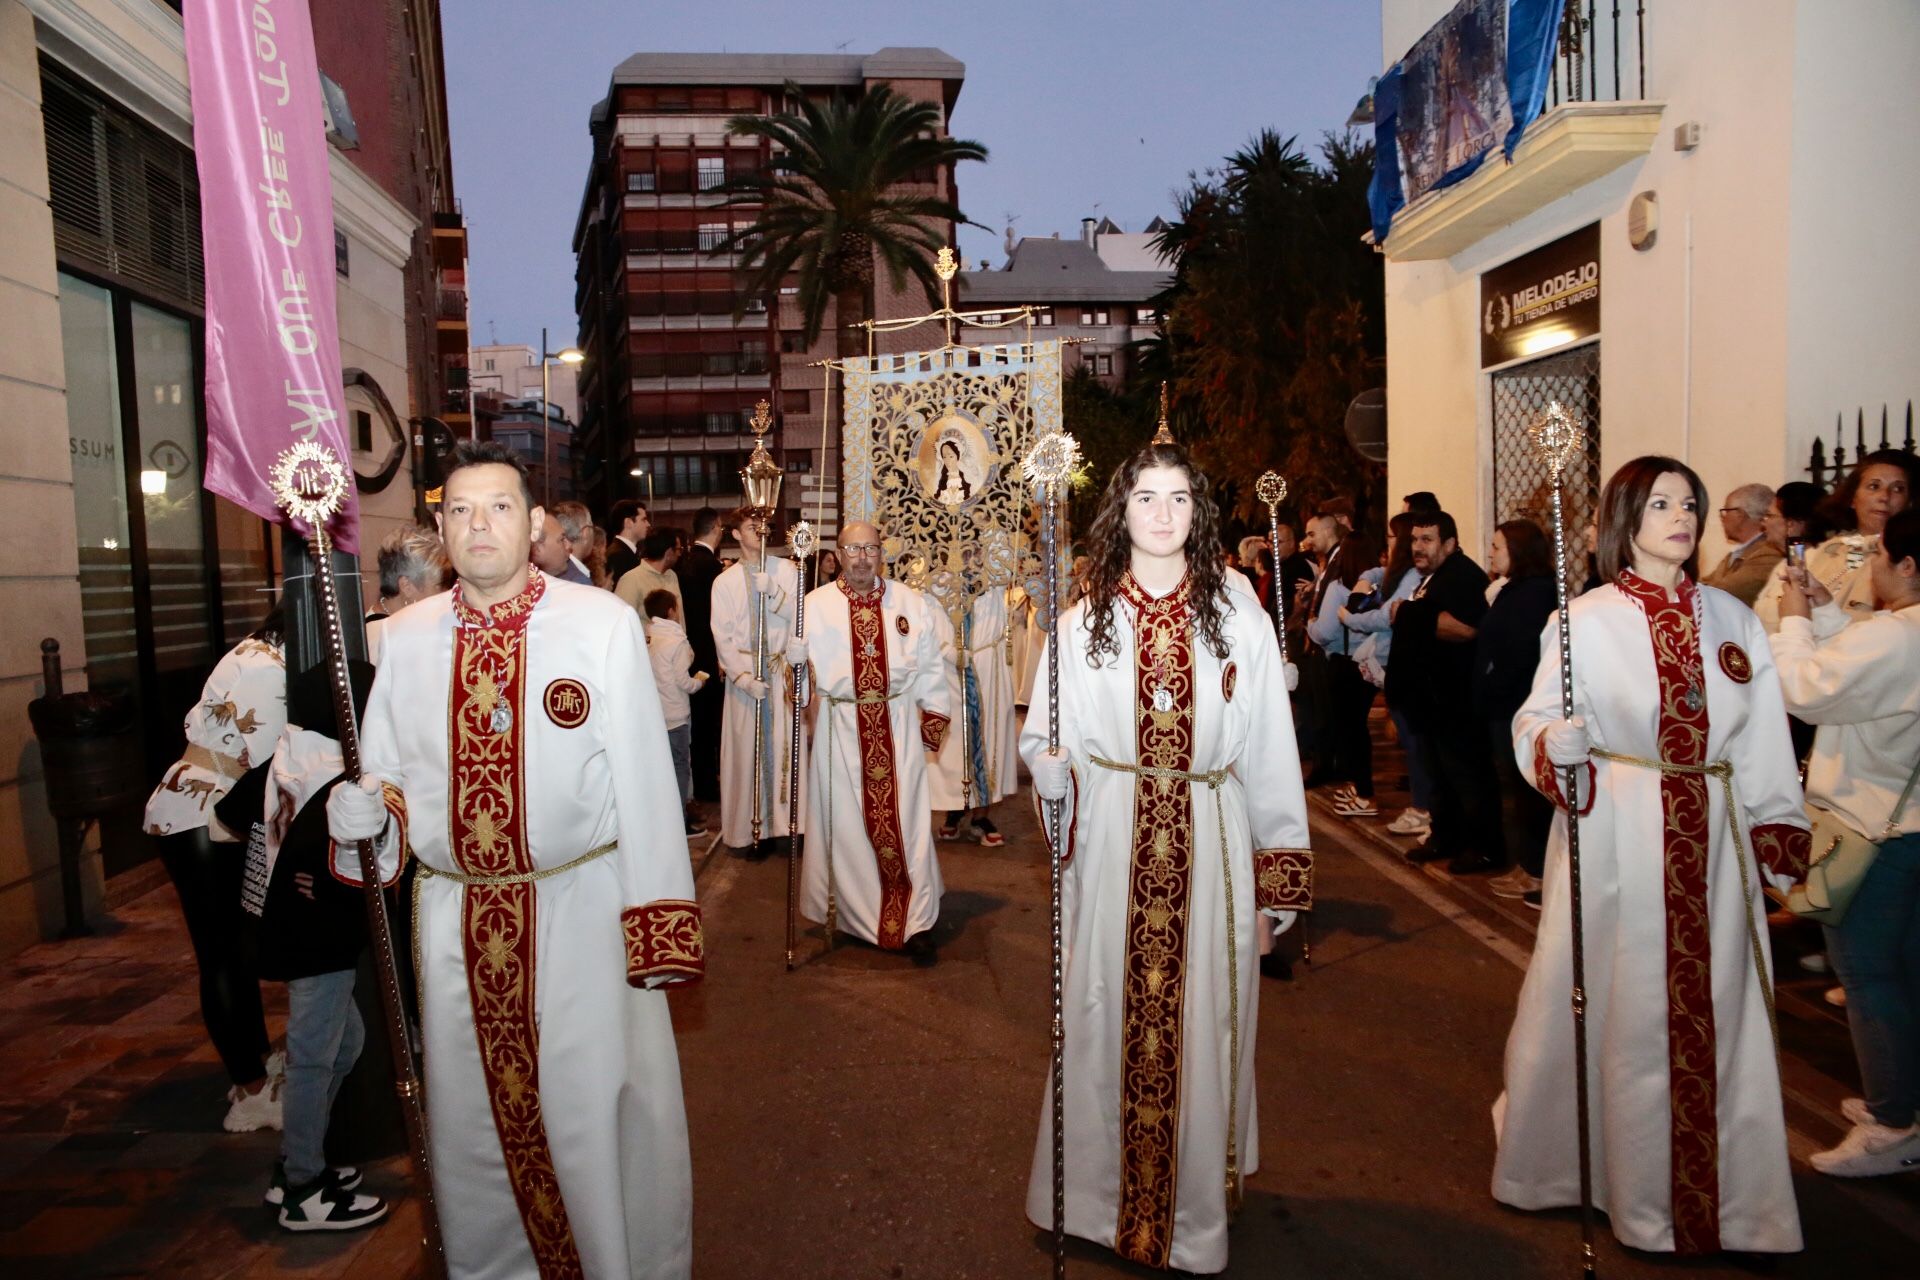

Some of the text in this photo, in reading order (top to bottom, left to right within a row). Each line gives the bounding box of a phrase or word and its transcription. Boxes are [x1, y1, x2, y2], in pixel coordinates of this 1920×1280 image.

[1512, 261, 1598, 310] MELODEJO
[1513, 286, 1598, 325] TU TIENDA DE VAPEO
